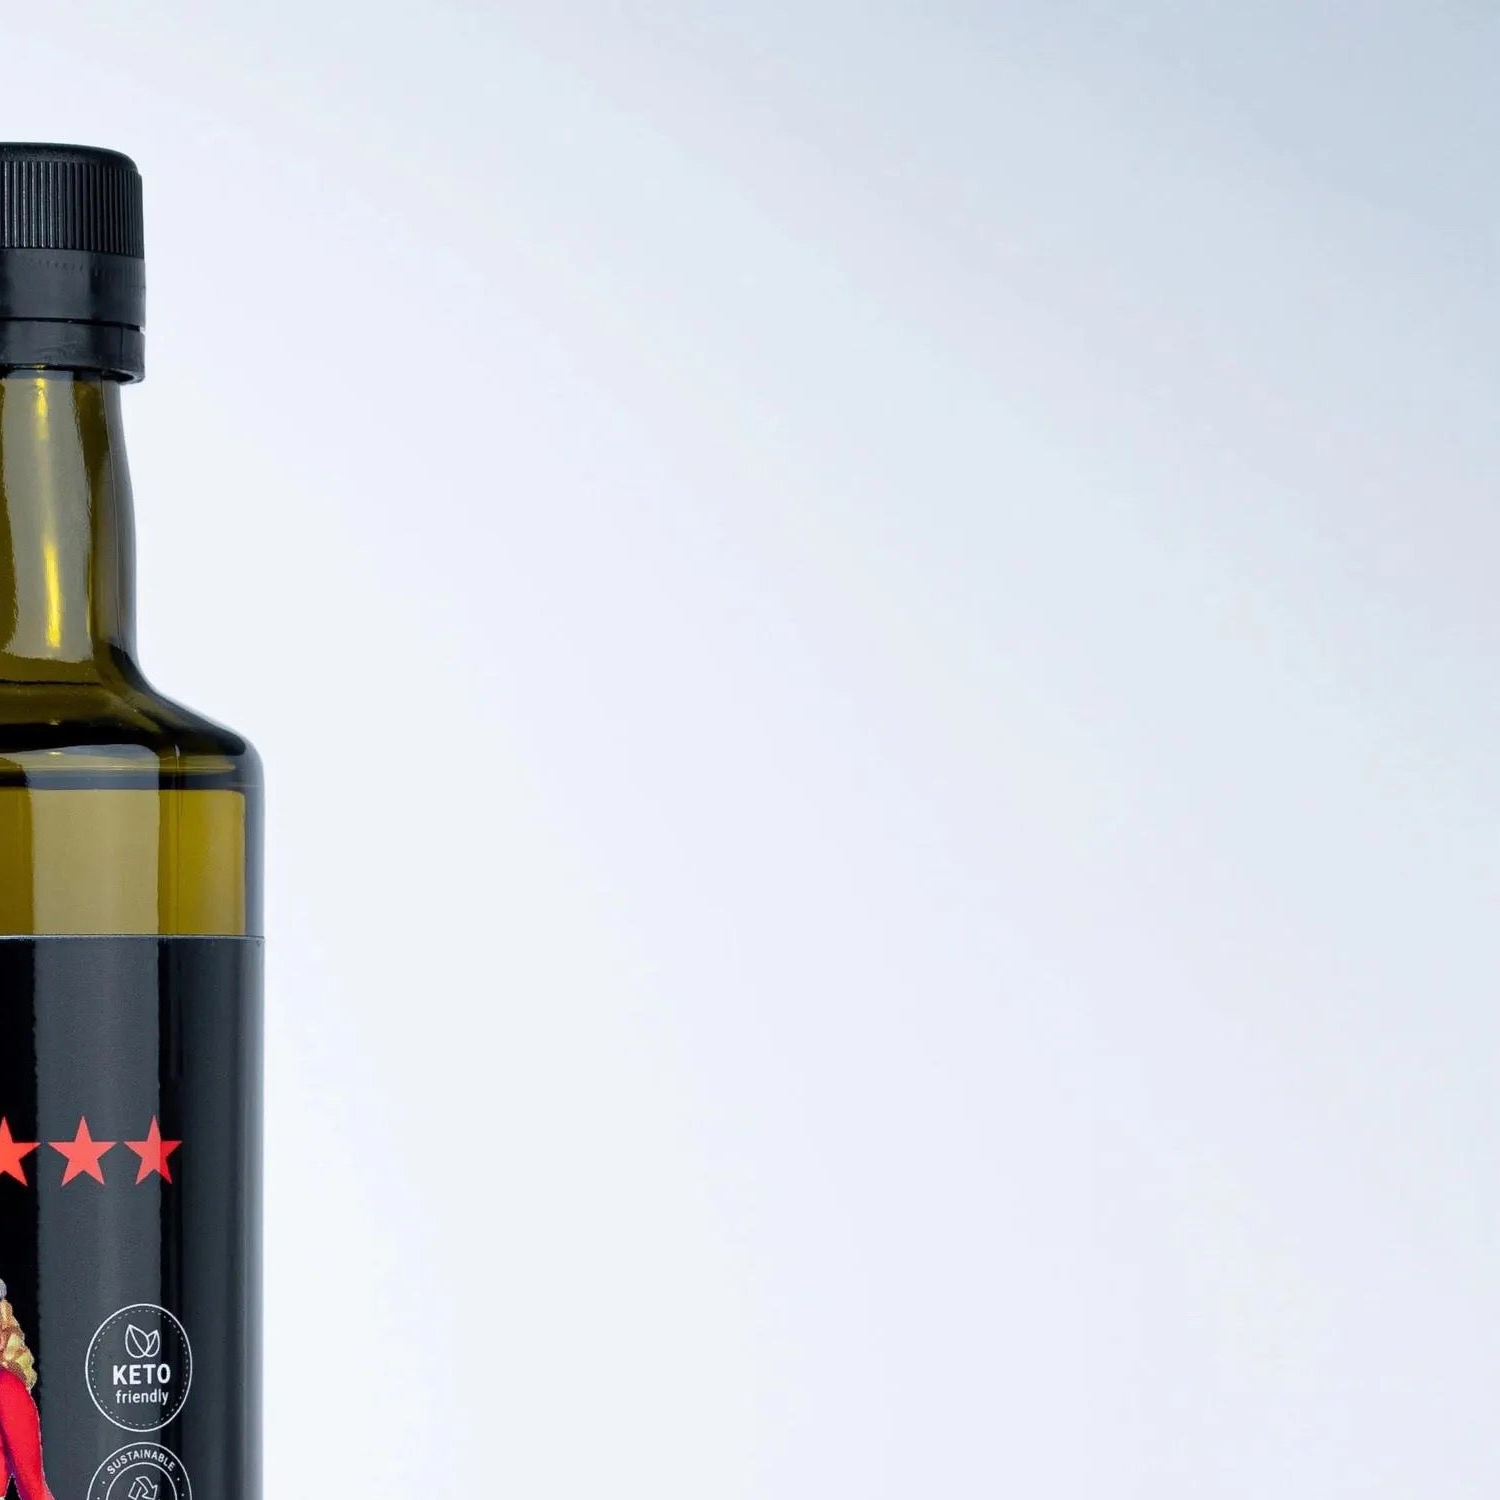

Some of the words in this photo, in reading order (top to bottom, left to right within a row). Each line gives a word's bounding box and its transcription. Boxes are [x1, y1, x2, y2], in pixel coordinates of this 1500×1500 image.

[112, 1363, 171, 1385] KETO
[116, 1389, 169, 1405] friendly
[107, 1449, 176, 1475] SUSTAINABLE
